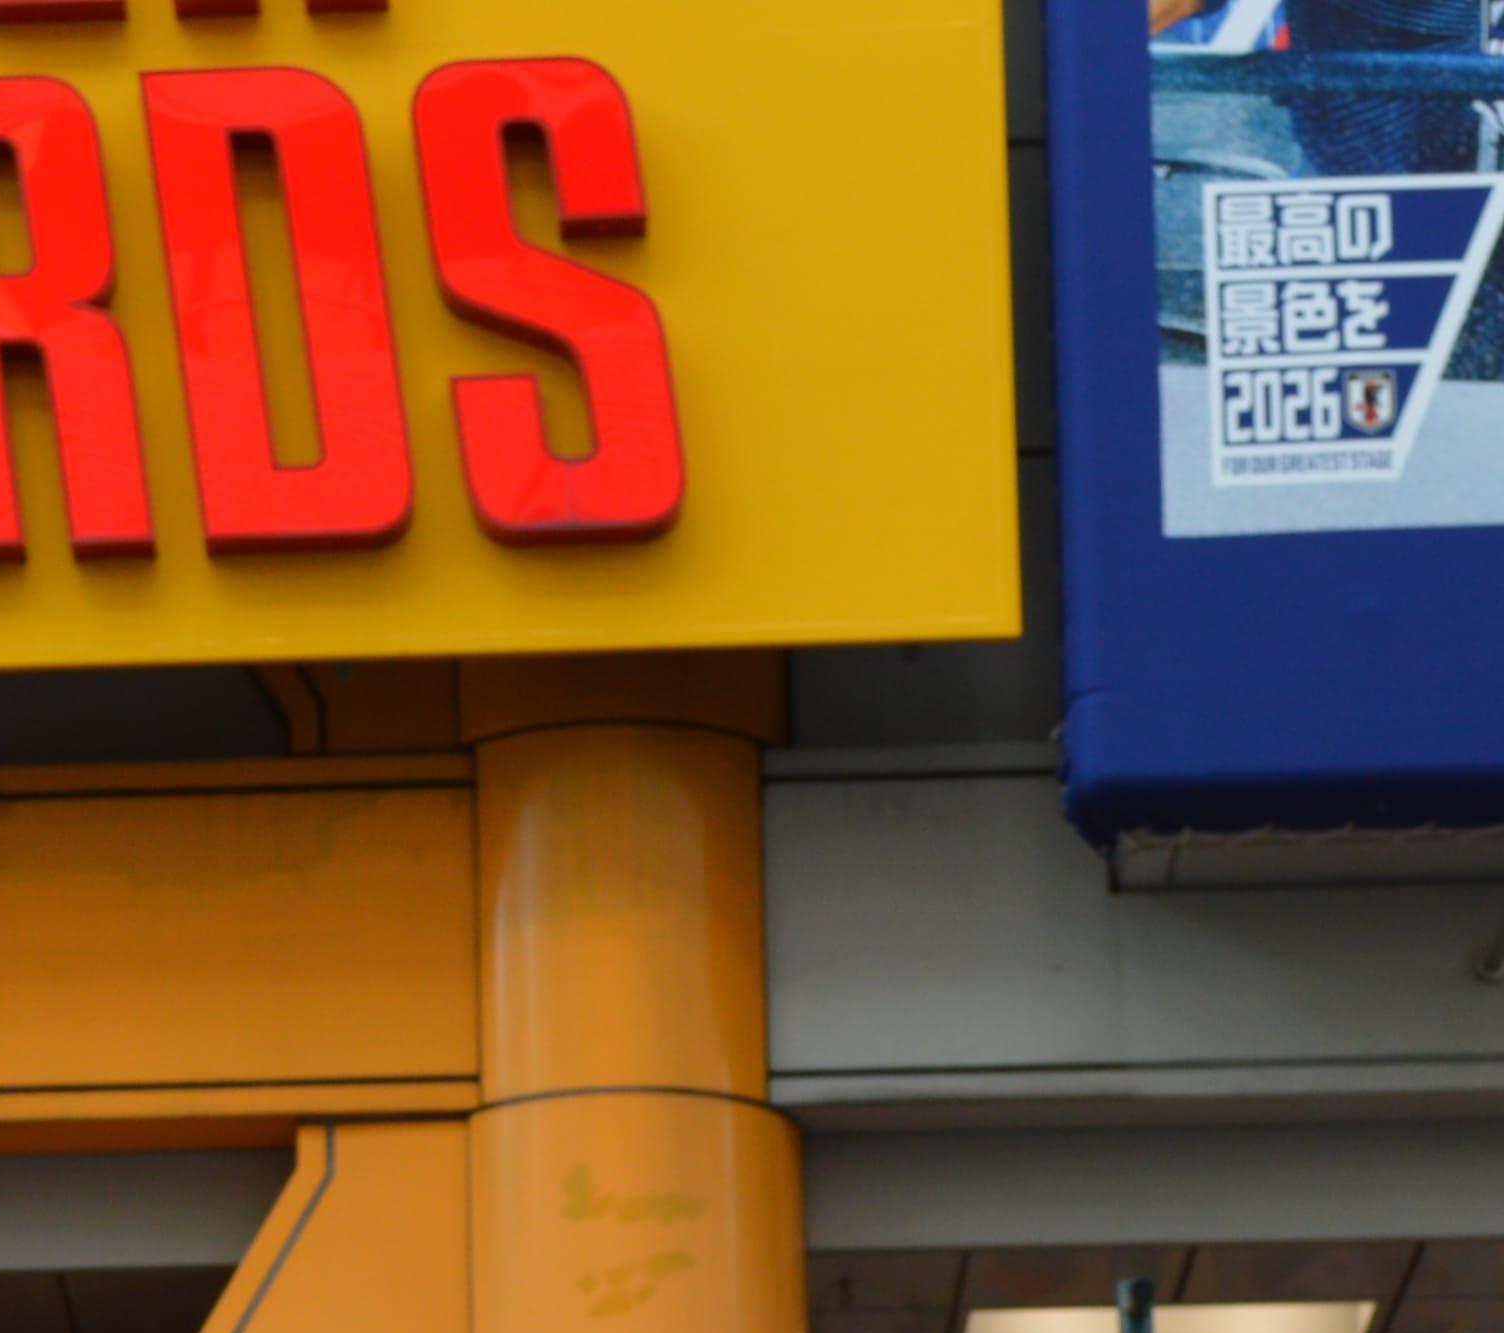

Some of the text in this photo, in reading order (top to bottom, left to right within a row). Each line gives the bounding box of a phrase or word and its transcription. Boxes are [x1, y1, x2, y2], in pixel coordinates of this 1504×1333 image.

[1218, 193, 1393, 267] 最高の
[1221, 280, 1390, 356] 景色を
[1224, 368, 1342, 444] 2026
